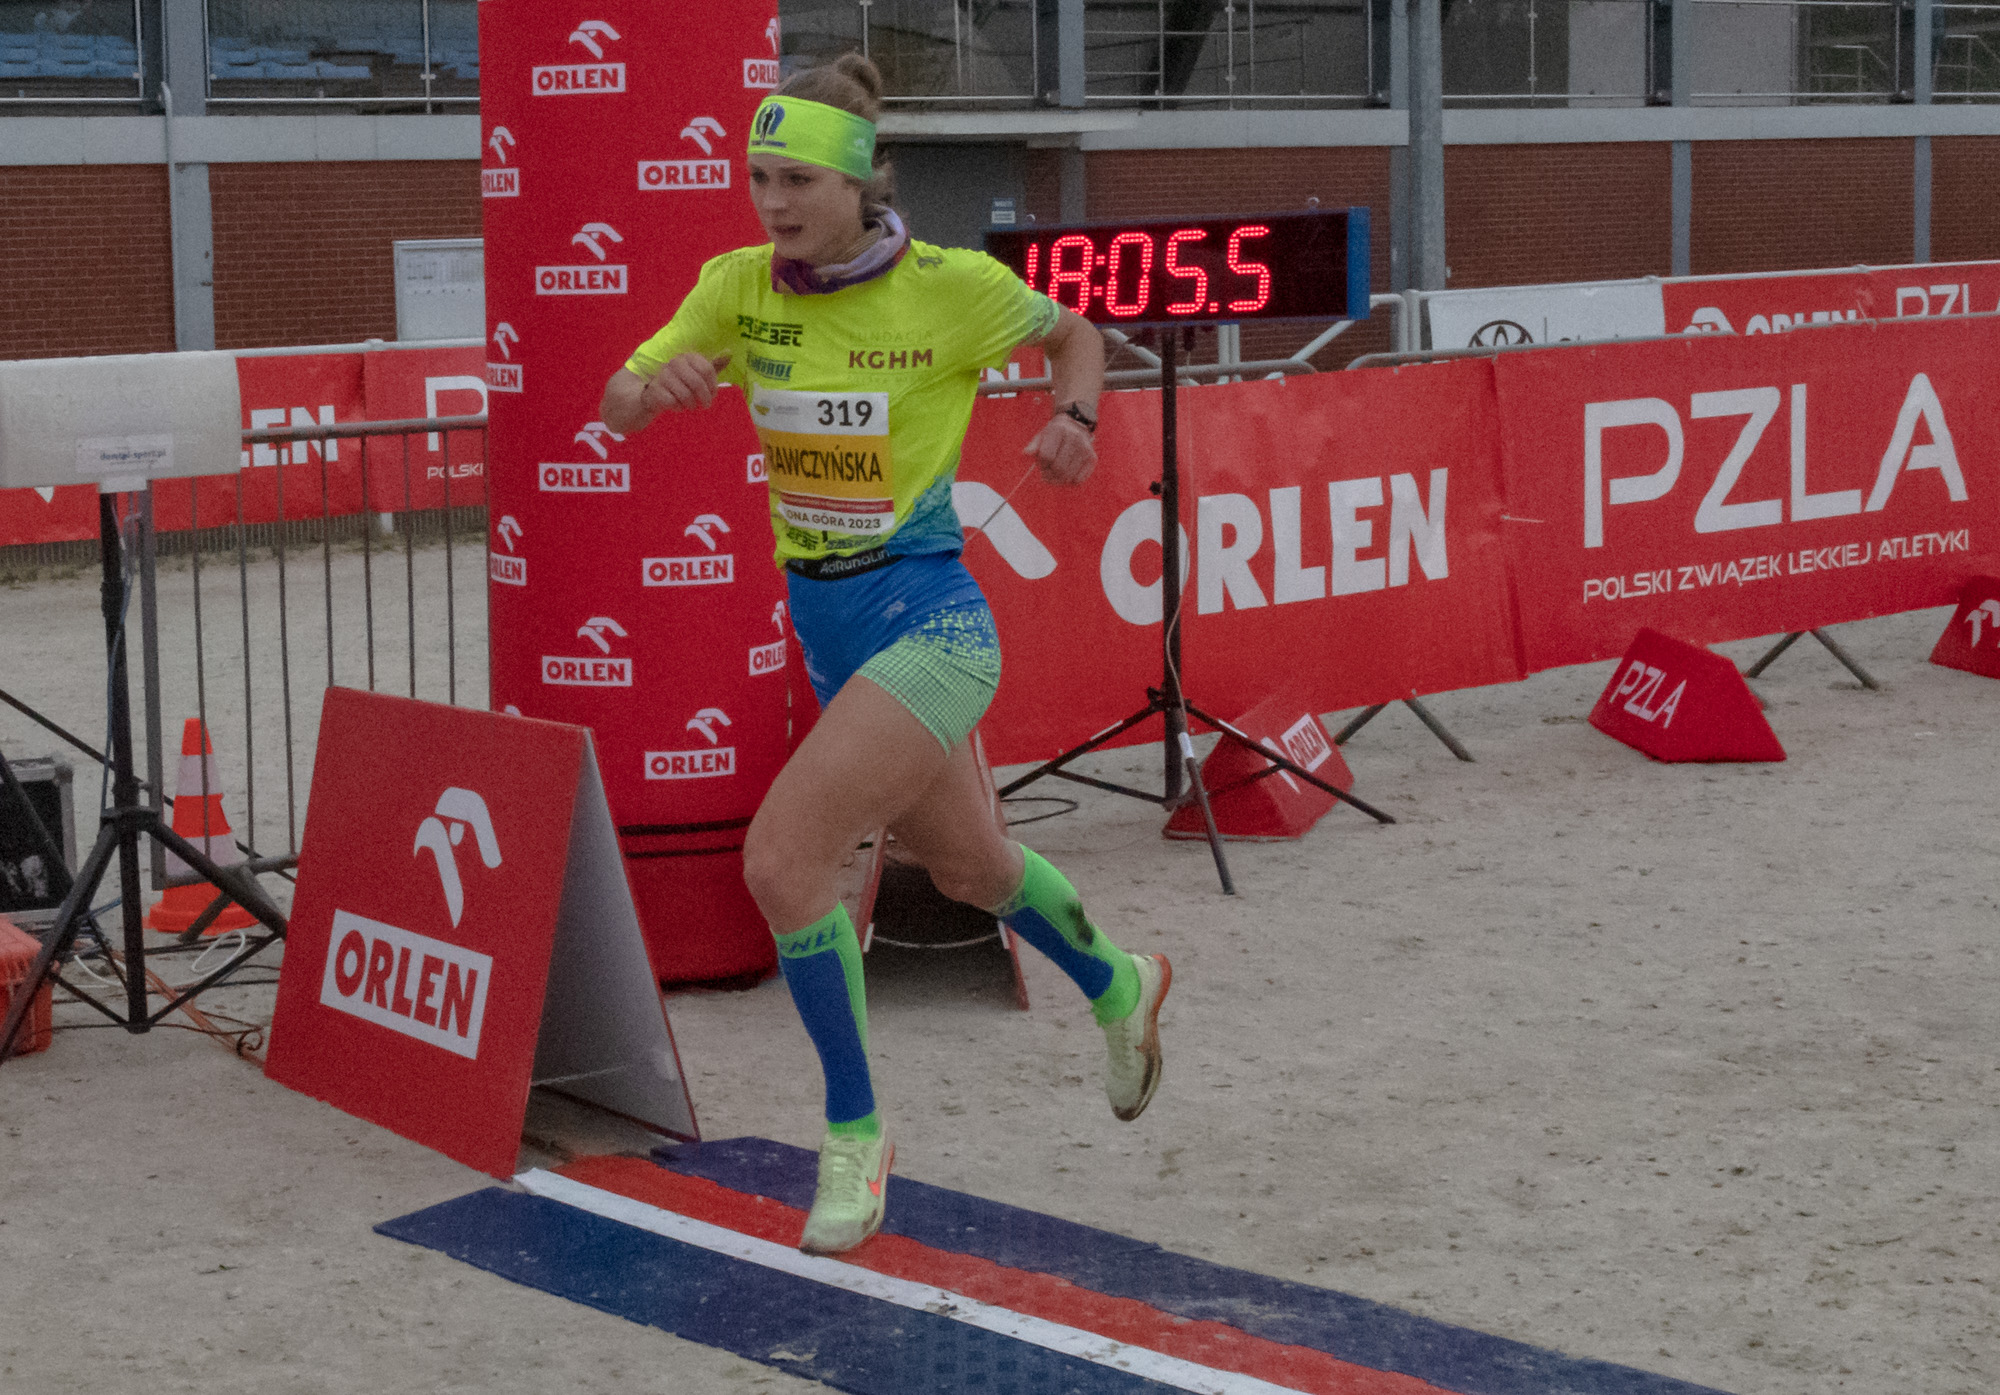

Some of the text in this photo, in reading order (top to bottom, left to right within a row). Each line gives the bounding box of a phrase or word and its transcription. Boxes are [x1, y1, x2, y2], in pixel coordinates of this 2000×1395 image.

[537, 68, 619, 91] ORLEN
[644, 164, 726, 186] ORLEN
[540, 269, 621, 291] ORLEN
[848, 348, 933, 370] KGHM
[817, 399, 873, 427] 319
[1584, 372, 1969, 548] PZLA
[543, 467, 624, 488] ORLEN
[812, 512, 846, 527] GÓRA
[848, 518, 881, 529] 2023
[1101, 467, 1449, 626] ORLEN
[648, 560, 729, 582] ORLEN
[1583, 529, 1969, 604] POLSKI ZWIĄZEK LEKKIEJ ATLETYKI
[546, 661, 627, 683] ORLEN
[1609, 660, 1687, 729] PZLA
[650, 752, 731, 775] ORLEN
[334, 929, 479, 1040] ORLEN
